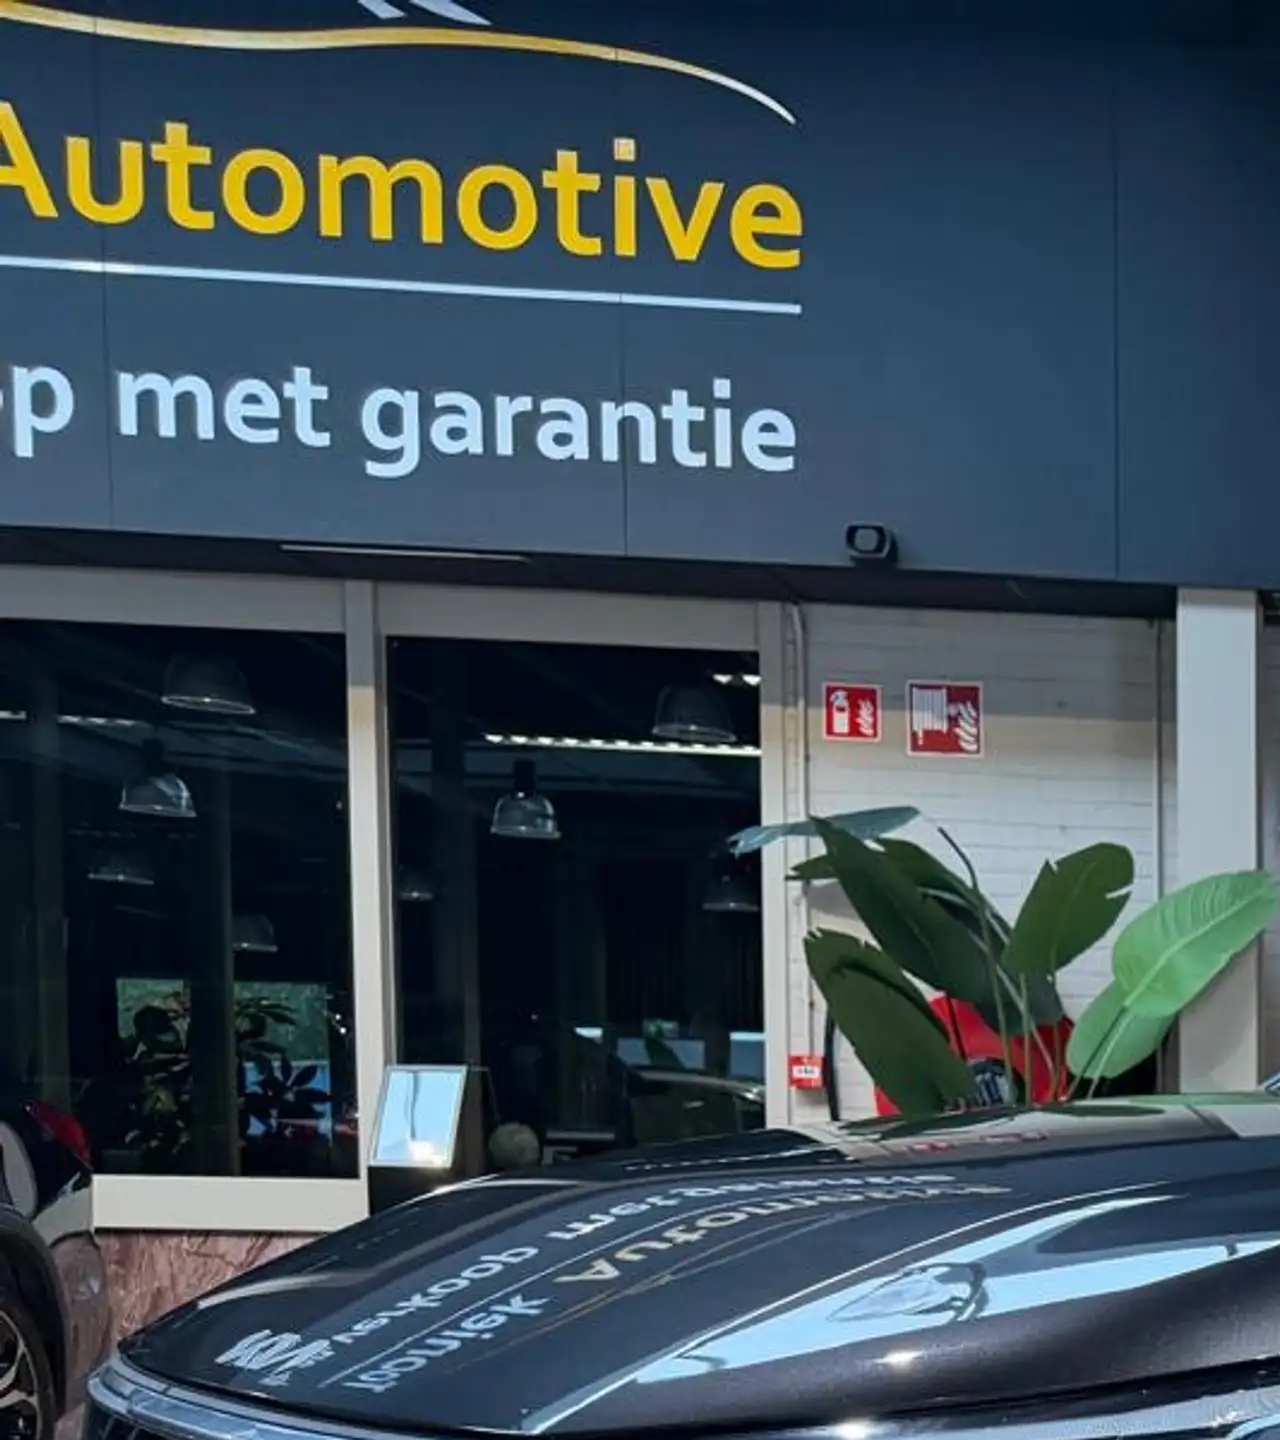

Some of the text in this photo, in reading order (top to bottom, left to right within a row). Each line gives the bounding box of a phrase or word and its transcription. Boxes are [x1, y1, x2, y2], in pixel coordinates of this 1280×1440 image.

[0, 99, 803, 269] Automotive
[0, 365, 797, 479] p met garantie
